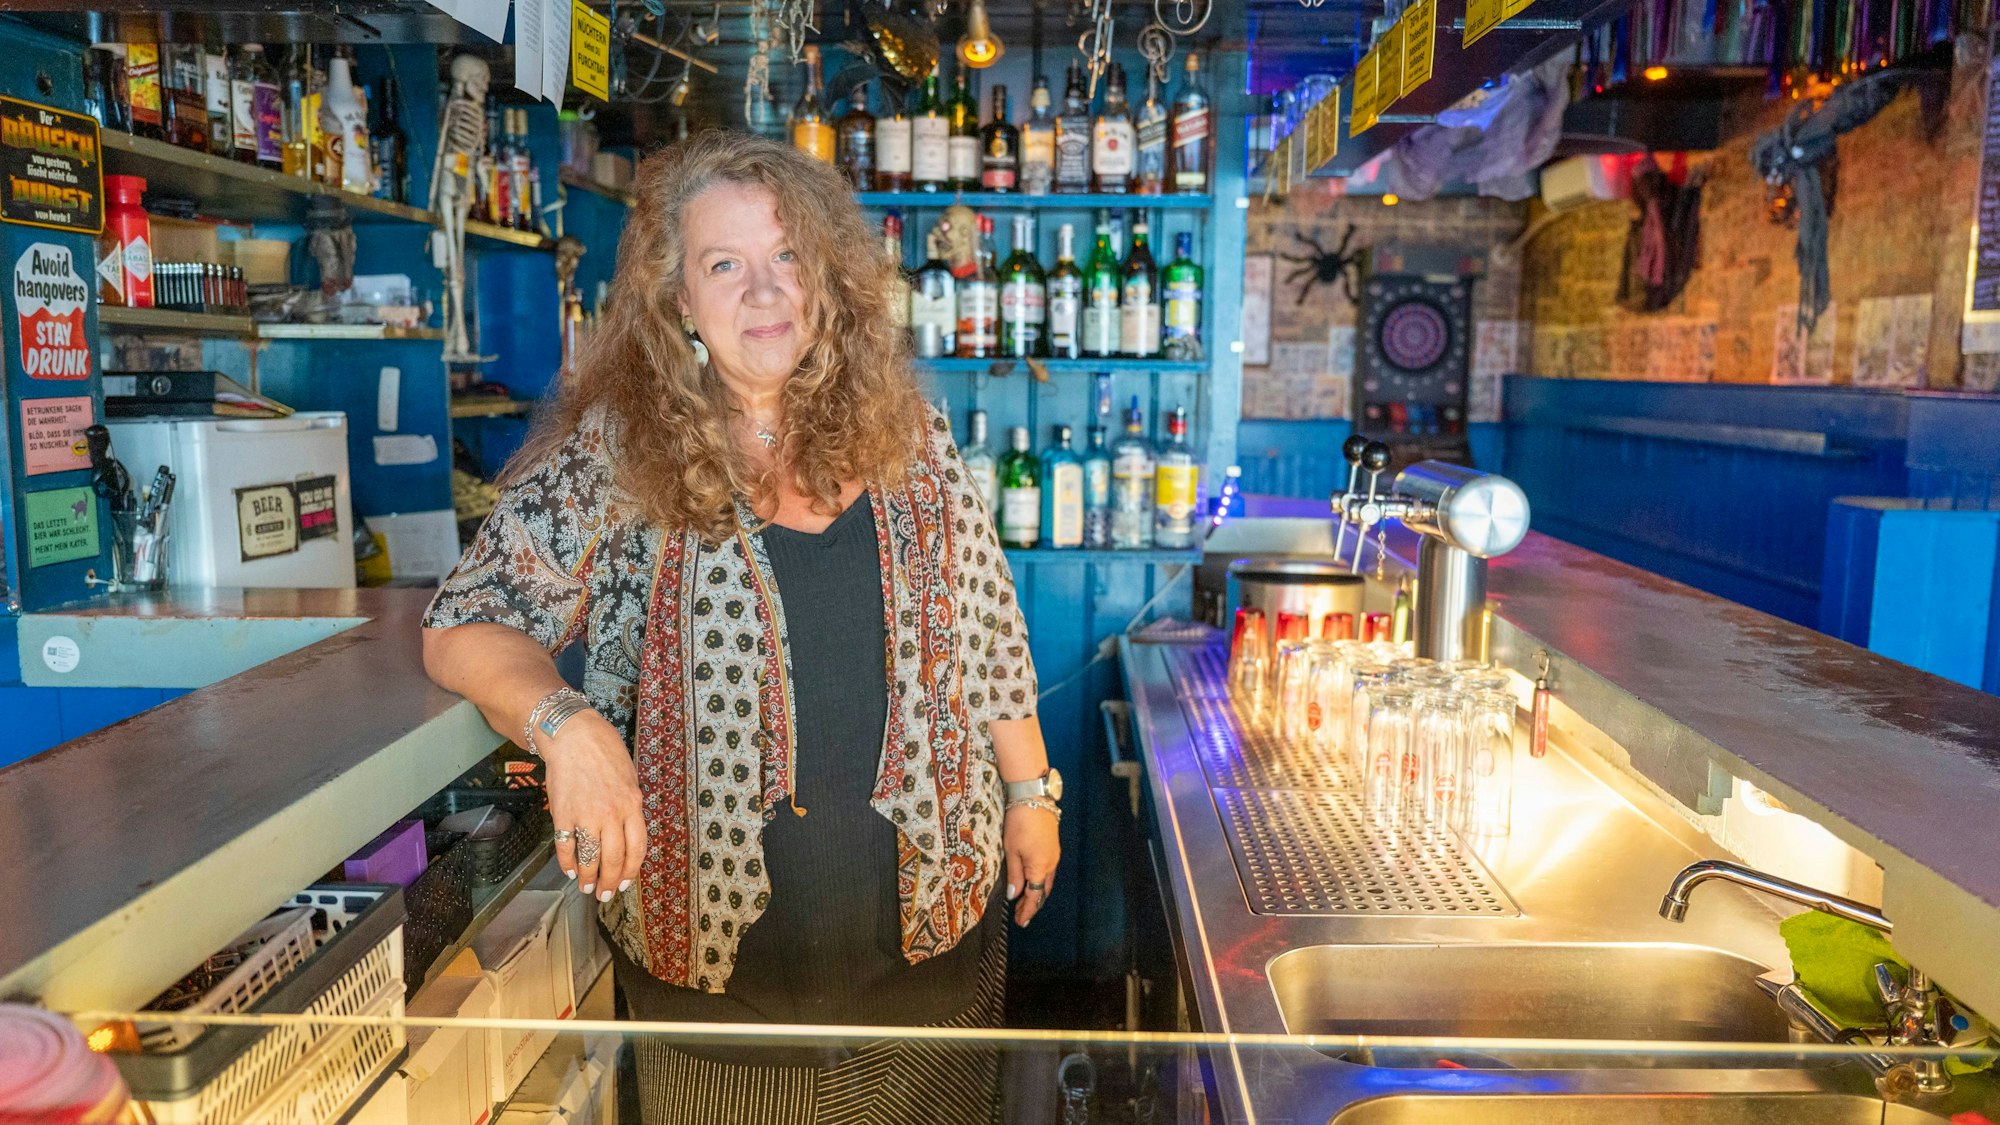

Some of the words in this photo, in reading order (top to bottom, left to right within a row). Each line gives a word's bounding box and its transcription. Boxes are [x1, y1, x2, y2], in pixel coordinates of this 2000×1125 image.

[578, 18, 606, 46] NÜCHTERN
[40, 111, 54, 126] Der
[1, 115, 96, 162] RAUSCH
[32, 155, 45, 165] von
[48, 169, 65, 182] nicht
[66, 172, 78, 184] den
[11, 179, 92, 213] DURST
[35, 210, 48, 220] von
[32, 249, 69, 278] Avoid
[16, 271, 85, 307] hangovers
[36, 321, 72, 347] STAY
[27, 347, 89, 376] DRUNK
[27, 405, 64, 415] BETRUNKENE
[65, 404, 82, 413] SAGEN
[28, 418, 36, 426] DIE
[39, 416, 69, 425] WAHRHEIT.
[29, 431, 46, 440] BLÖD,
[47, 430, 61, 439] DASS
[62, 429, 71, 437] SIE
[72, 428, 86, 437] IMM
[30, 442, 37, 450] SO
[253, 496, 283, 516] BEER
[33, 521, 44, 530] DAS
[46, 518, 67, 528] LETZTE
[34, 532, 47, 540] BIER
[49, 530, 61, 538] WAR
[35, 544, 53, 554] MEINT
[54, 541, 68, 551] MEIN
